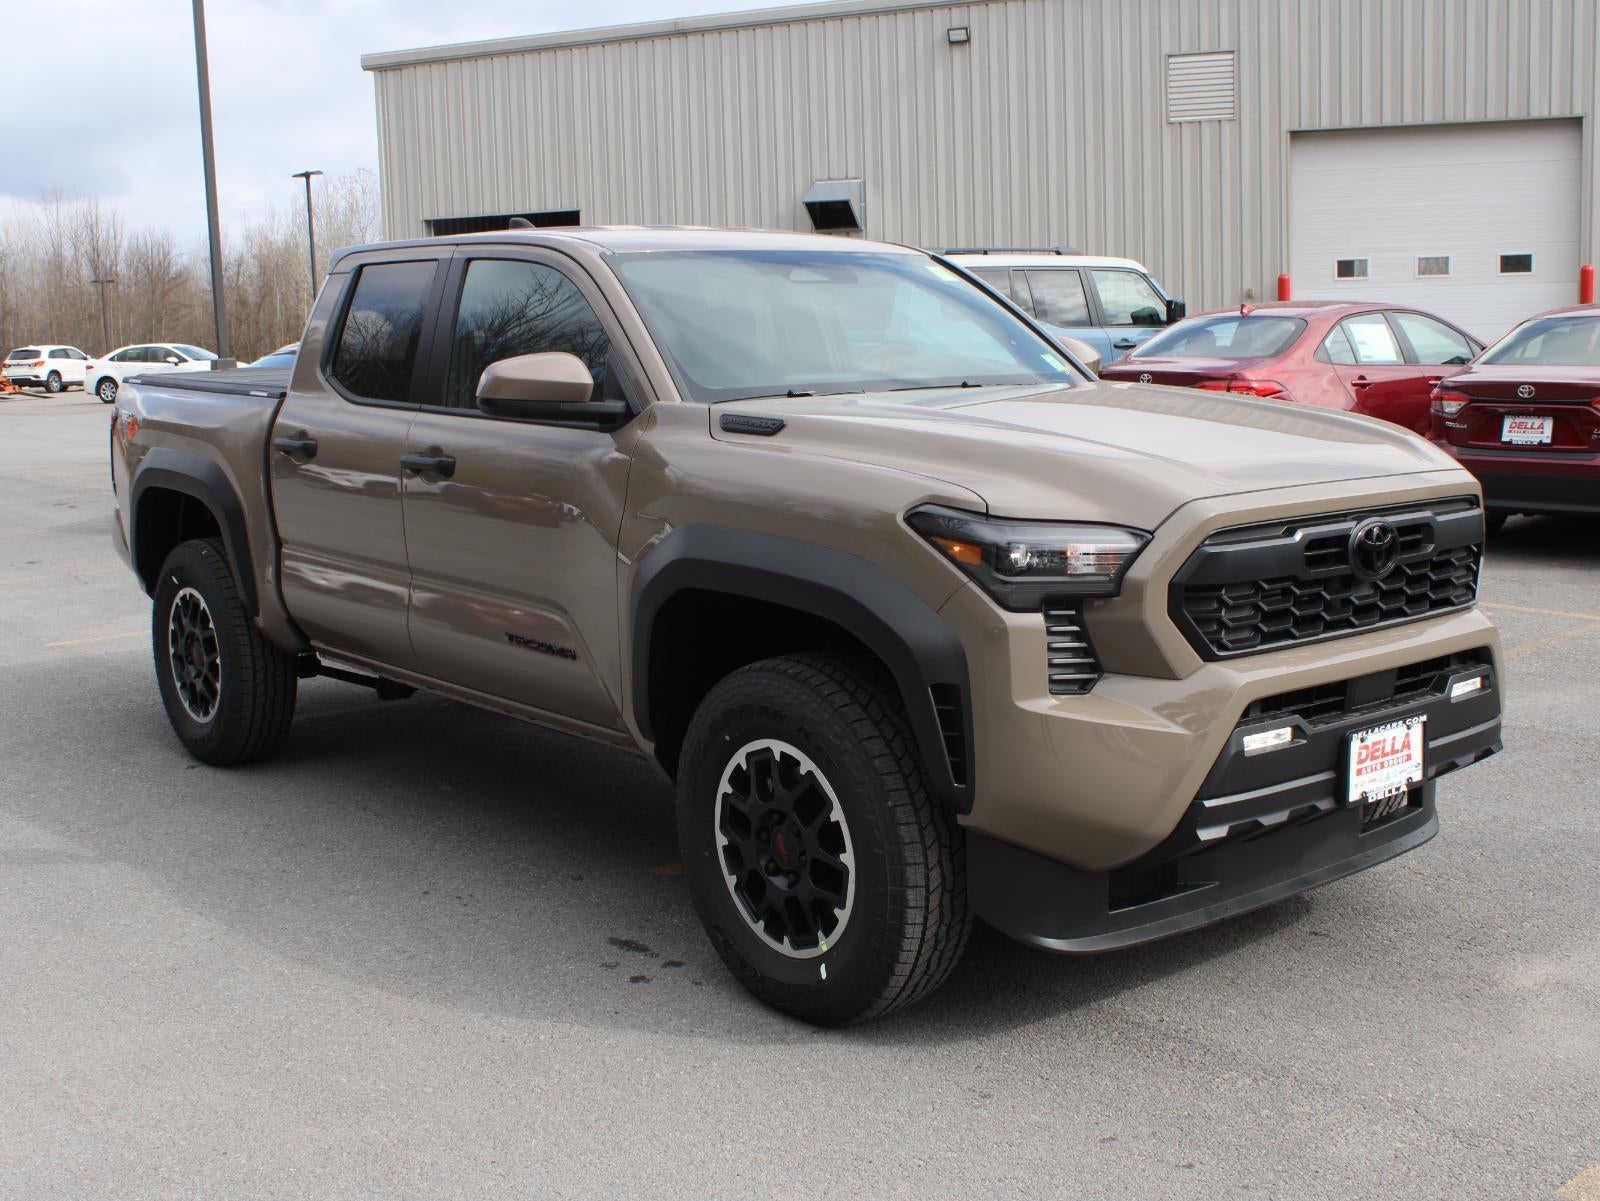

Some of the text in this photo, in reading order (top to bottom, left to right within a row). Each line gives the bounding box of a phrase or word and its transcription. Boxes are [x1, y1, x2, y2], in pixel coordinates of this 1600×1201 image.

[1508, 421, 1545, 430] DELLA
[1352, 714, 1427, 740] DELLACARS.COM
[1356, 731, 1411, 765] DELLA
[1361, 762, 1381, 775] AUTO
[1383, 755, 1407, 768] GROUP
[1368, 784, 1407, 803] DELLA
